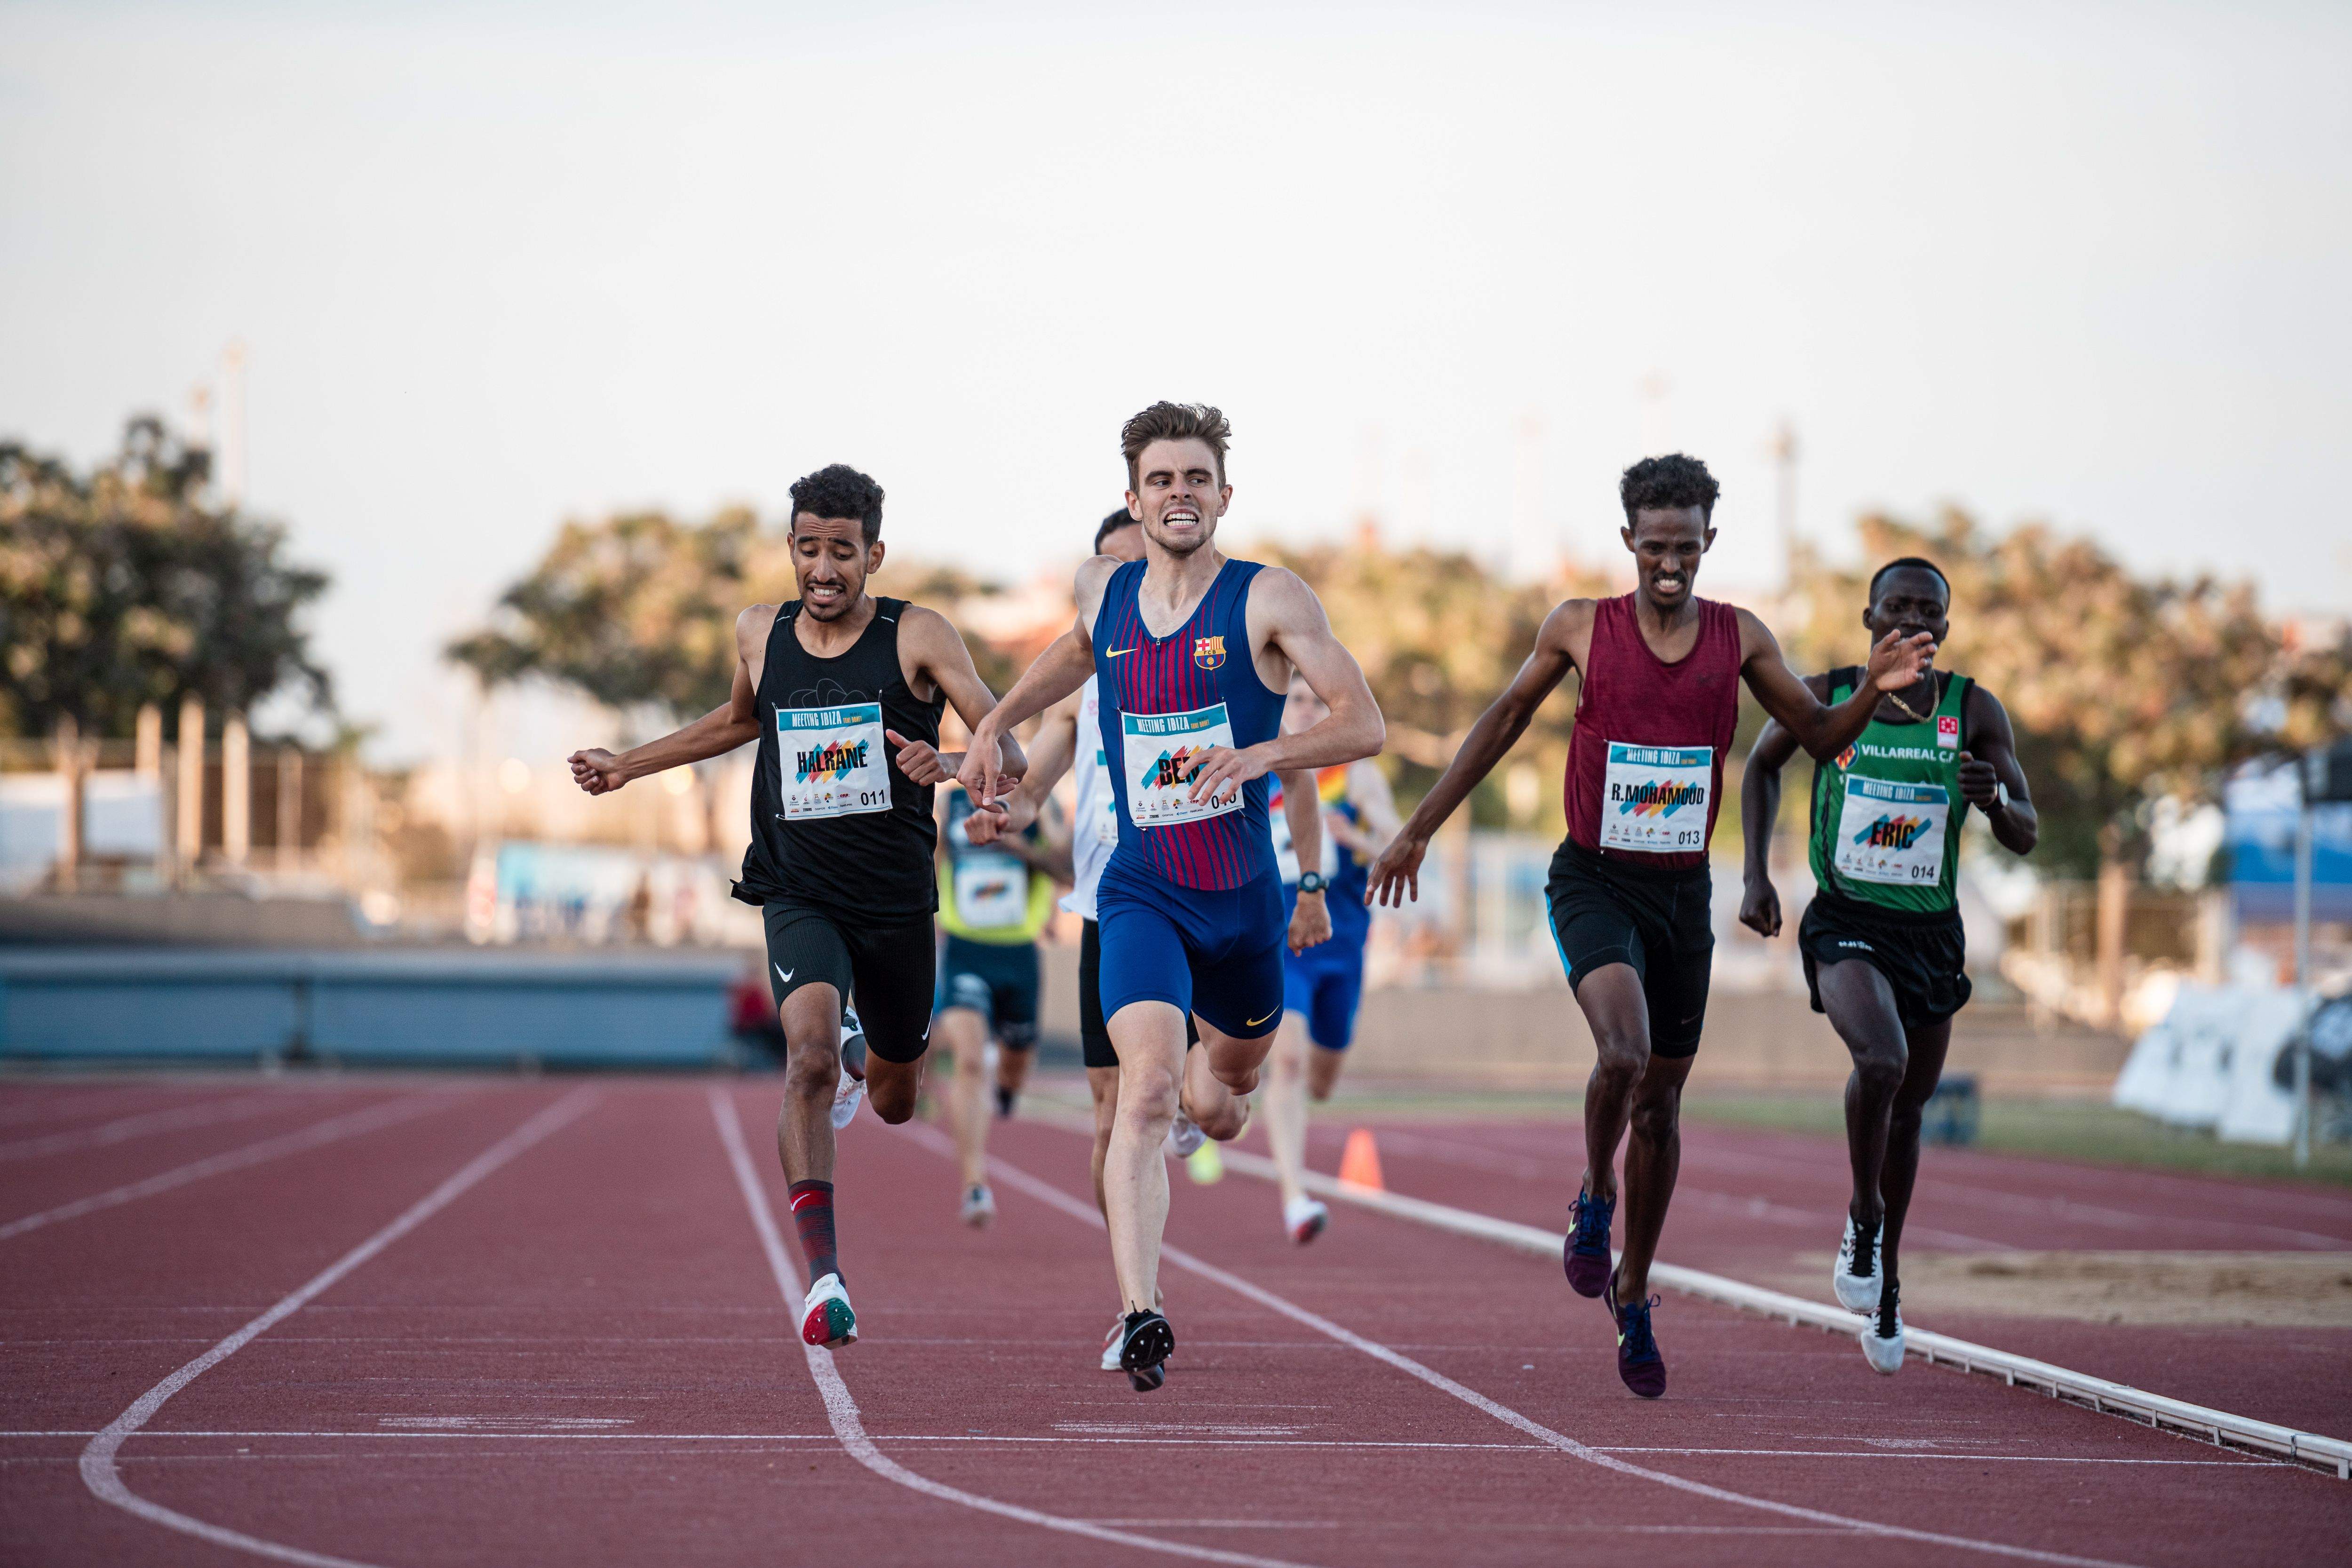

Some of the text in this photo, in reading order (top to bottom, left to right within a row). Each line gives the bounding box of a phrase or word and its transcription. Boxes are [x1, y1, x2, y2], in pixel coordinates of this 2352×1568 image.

[792, 710, 842, 727] MEETING IBIZA
[1136, 718, 1165, 732] MEETING
[1167, 716, 1190, 732] IBIZA
[797, 746, 868, 773] HALRANE
[1627, 748, 1658, 764] MEETING
[1661, 750, 1680, 764] IBIZA
[1862, 744, 1937, 761] VILLARREAL
[860, 789, 885, 806] 011
[1612, 783, 1705, 805] R.MOHAMOUD
[1863, 780, 1915, 800] MEETING IBIZA
[1211, 792, 1236, 809] 00
[1678, 830, 1700, 844] 013
[1871, 821, 1915, 848] ERIC
[1912, 865, 1935, 879] 014
